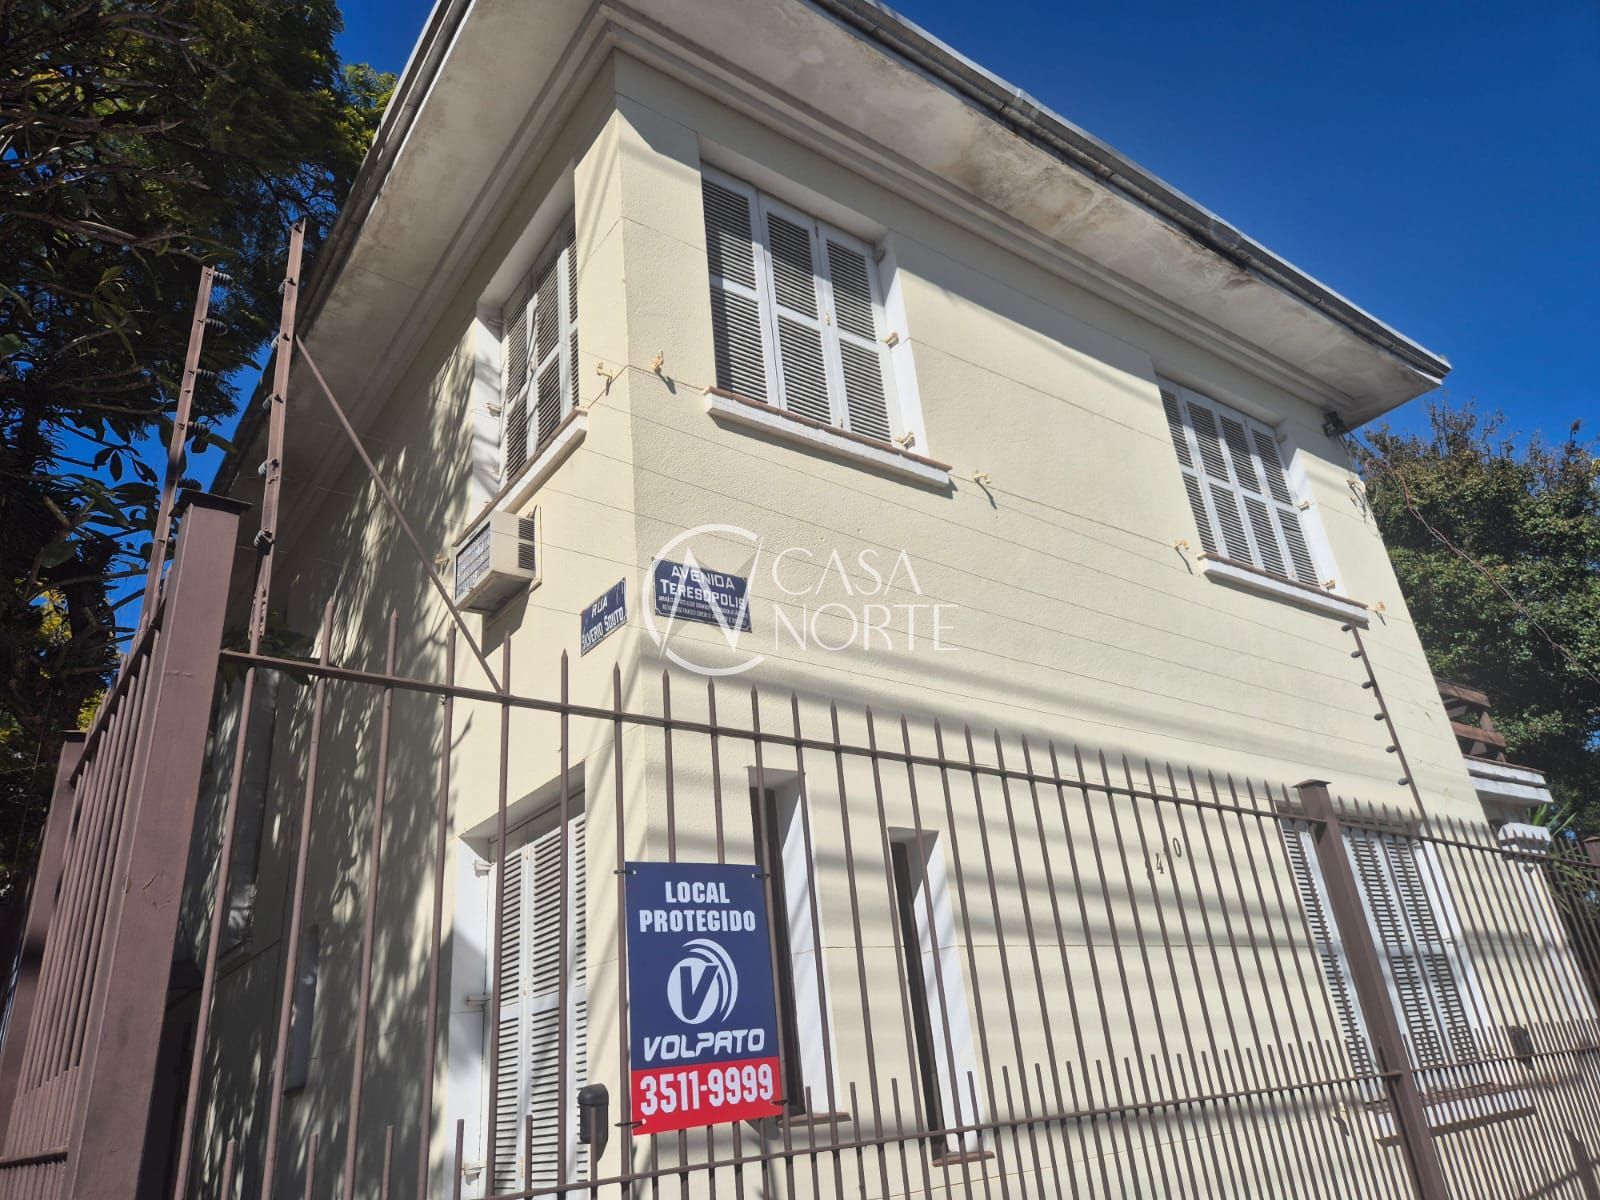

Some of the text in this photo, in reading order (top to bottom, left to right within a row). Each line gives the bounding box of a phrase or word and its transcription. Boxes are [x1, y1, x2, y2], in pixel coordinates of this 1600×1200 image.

[671, 566, 735, 590] AVENIDA
[591, 595, 608, 618] RUA
[603, 606, 624, 632] SOUTO
[665, 880, 730, 904] LOCAL
[639, 909, 756, 932] PROTEGIDO
[643, 1027, 765, 1062] VOLPATO
[639, 1063, 774, 1116] 3511-9999
